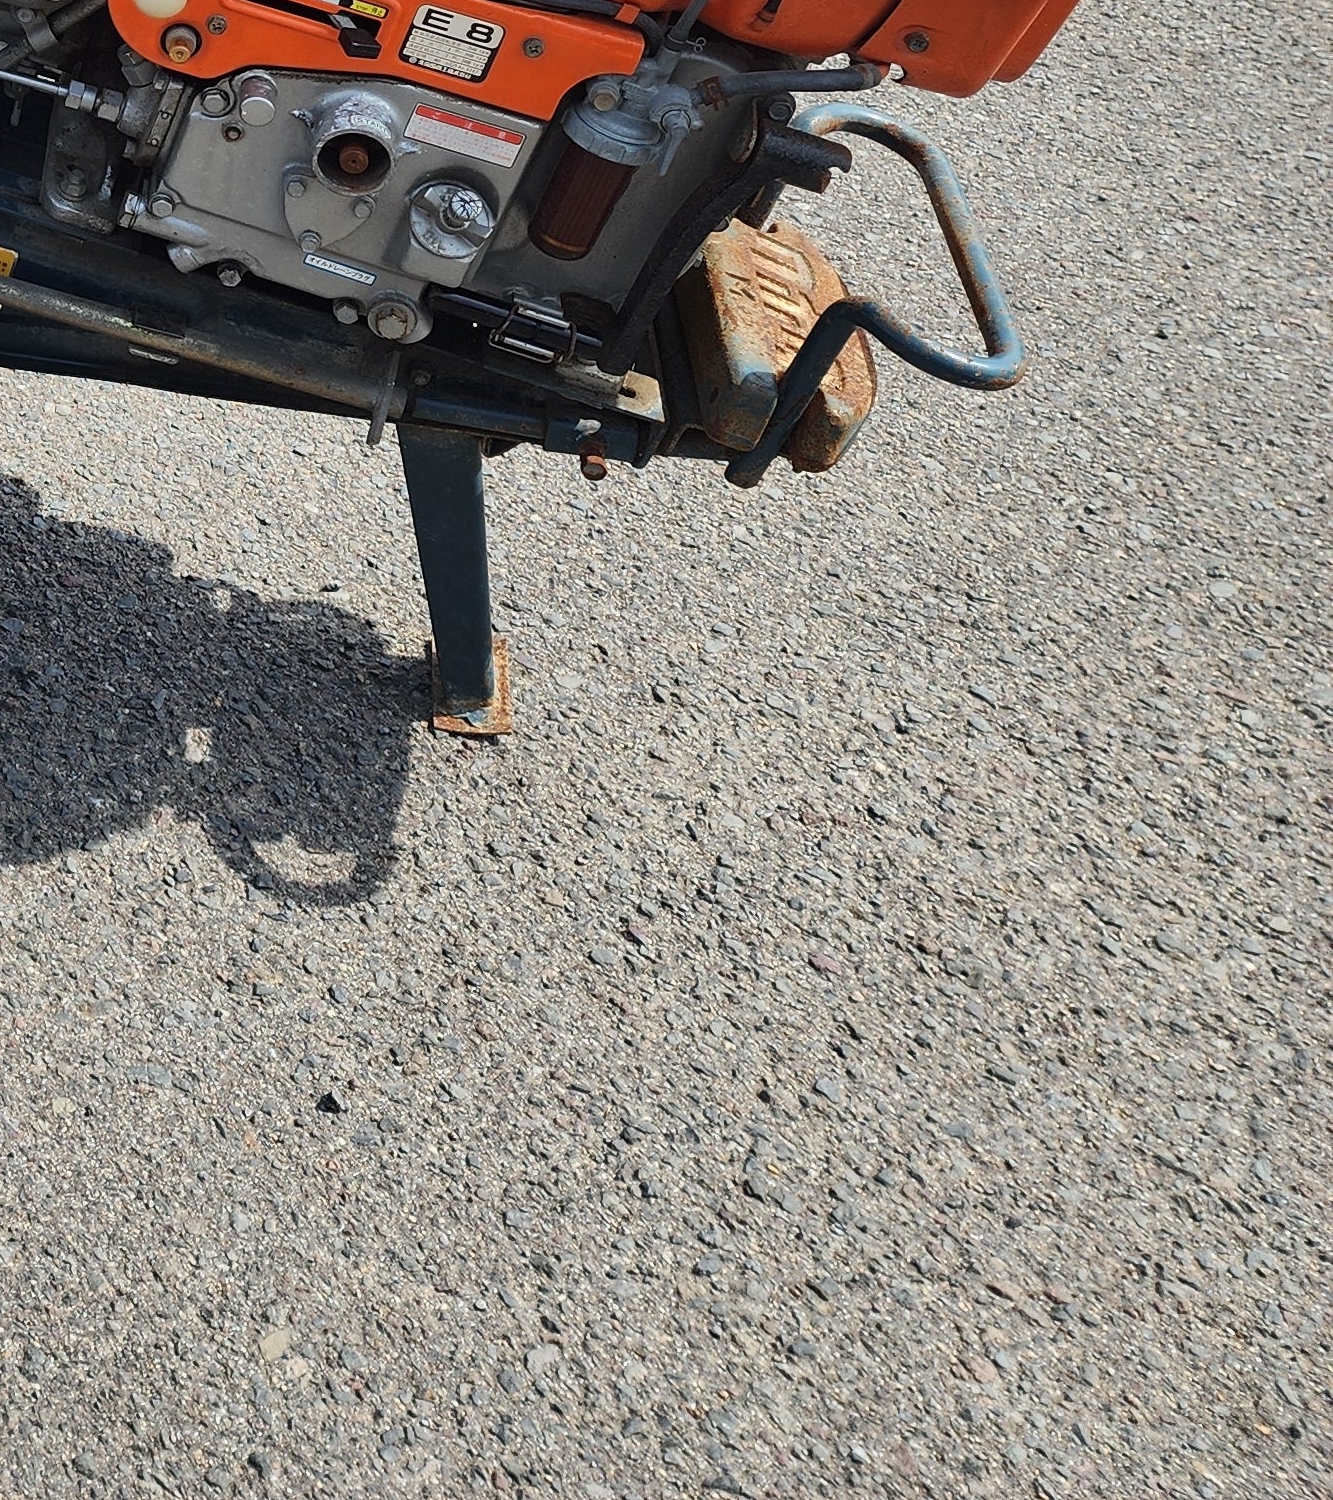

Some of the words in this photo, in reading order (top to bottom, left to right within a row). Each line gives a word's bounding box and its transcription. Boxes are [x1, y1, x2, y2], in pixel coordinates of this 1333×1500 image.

[307, 256, 372, 283] オイルドレーンプラグ
